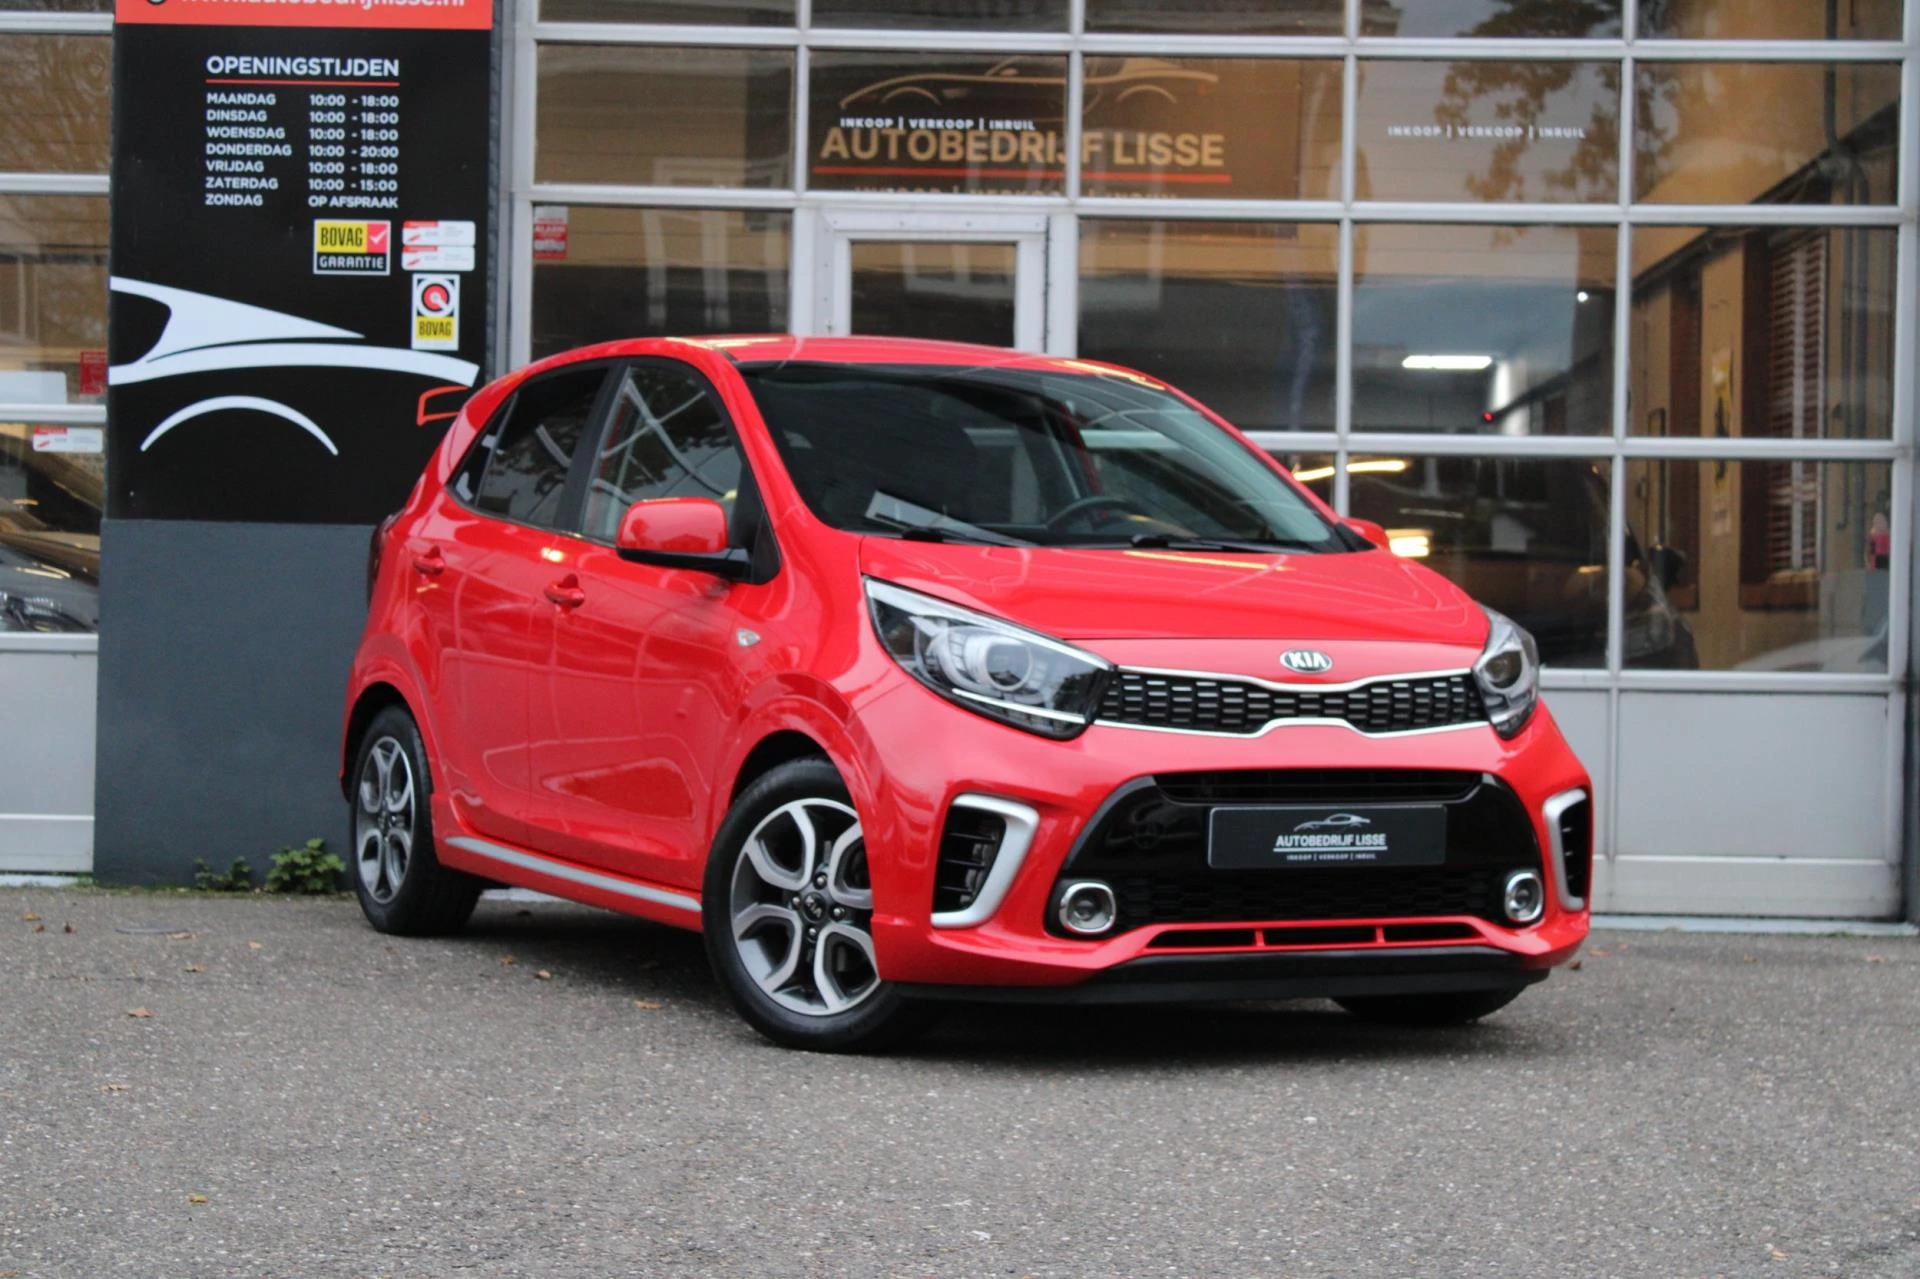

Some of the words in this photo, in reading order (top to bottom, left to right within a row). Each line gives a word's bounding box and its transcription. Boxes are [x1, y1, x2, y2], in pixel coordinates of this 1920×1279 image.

[207, 56, 399, 76] OPENINGSTIJDEN
[207, 93, 276, 105] MAANDAG
[310, 94, 345, 106] 10:00
[361, 95, 399, 107] 18:00
[207, 109, 267, 122] DINSDAG
[310, 111, 345, 123] 10:00
[361, 112, 398, 124] 18:00
[840, 118, 893, 129] INKOOP
[909, 118, 974, 130] VERKOOP
[989, 119, 1035, 130] INRUIL
[207, 126, 285, 139] WOENSDAG
[309, 128, 345, 140] 10:00
[361, 129, 398, 141] 18:00
[1388, 125, 1442, 137] INKOOP
[1456, 126, 1524, 138] VERKOOP
[1539, 127, 1586, 138] INRUIL
[206, 143, 292, 156] DONDERDAG
[309, 145, 345, 157] 10:00
[360, 146, 399, 158] 20:00
[1113, 132, 1225, 167] LISSE
[206, 160, 264, 172] VRIJDAG
[309, 162, 344, 174] 10:00
[360, 163, 398, 174] 18:00
[206, 177, 278, 189] ZATERDAG
[309, 179, 344, 190] 10:00
[360, 180, 397, 191] 15:00
[205, 193, 263, 206] ZONDAG
[308, 195, 327, 207] OP
[329, 196, 398, 208] AFSPRAAK
[321, 227, 363, 247] BOVAG
[319, 255, 384, 269] GARANTIE
[419, 321, 452, 337] BOVAG
[1287, 651, 1328, 669] KIA
[1276, 835, 1353, 847] AUTOBEDRIJF
[1355, 834, 1387, 846] LISSE
